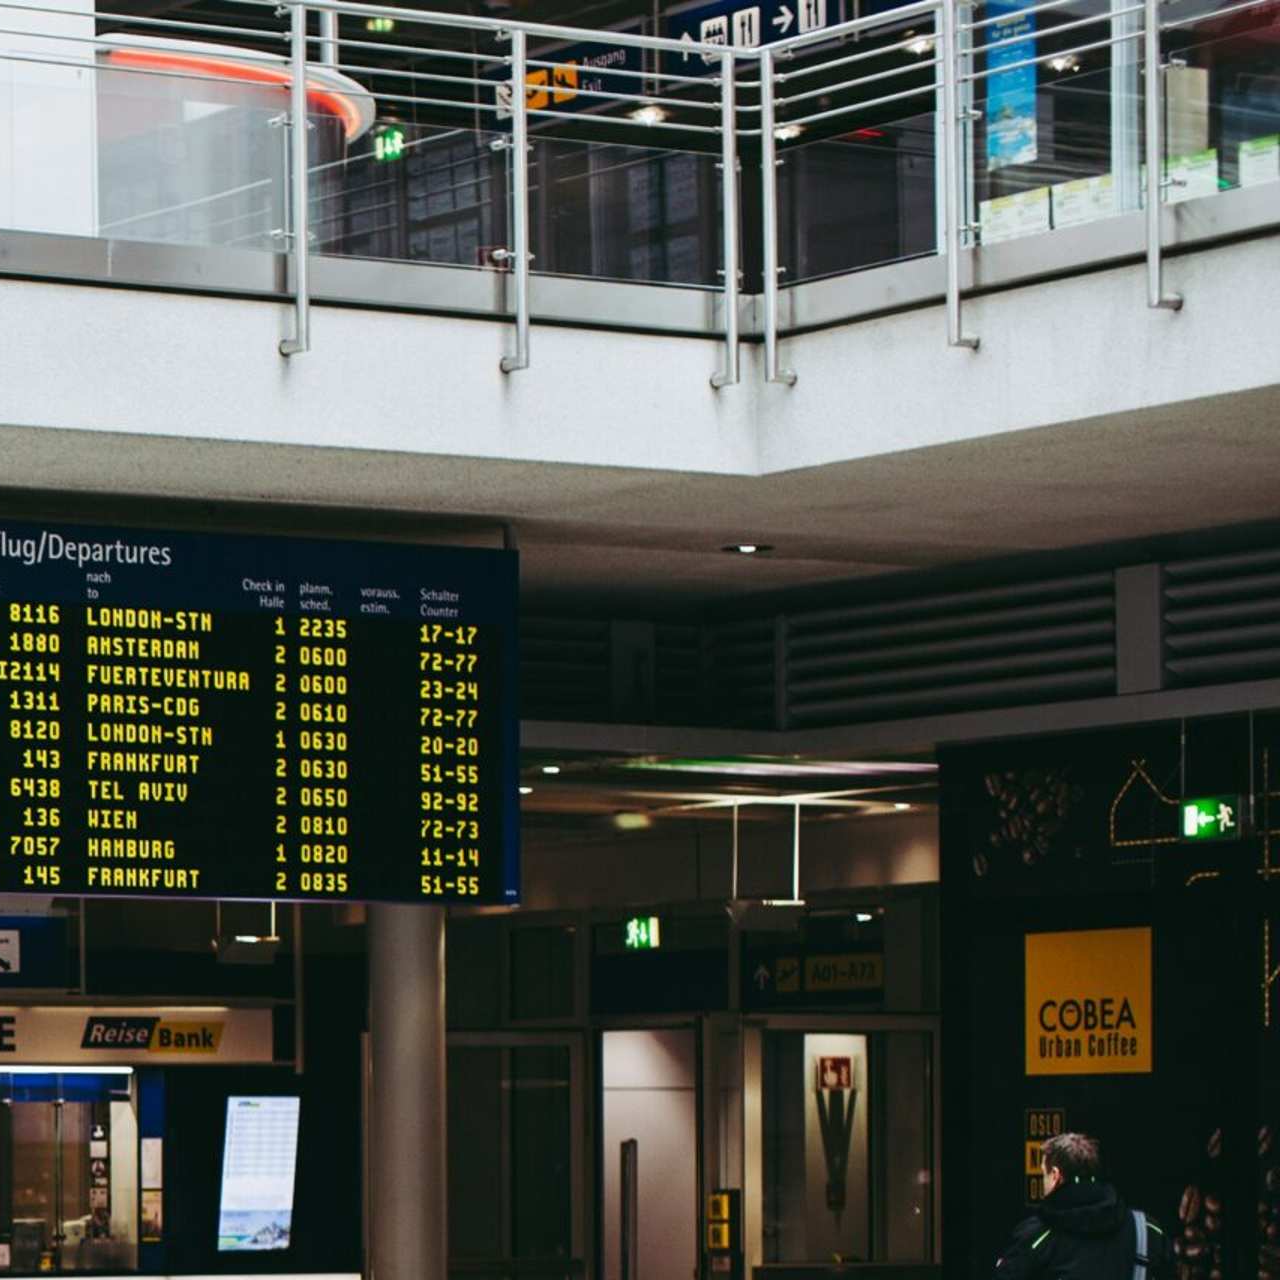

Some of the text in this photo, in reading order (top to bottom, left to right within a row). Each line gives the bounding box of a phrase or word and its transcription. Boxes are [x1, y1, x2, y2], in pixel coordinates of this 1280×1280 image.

[582, 47, 627, 71] Ausgang
[9, 604, 60, 623] 8116
[86, 608, 212, 631] LONDON-STN
[275, 618, 286, 634] 1
[299, 618, 347, 638] 2235
[420, 625, 477, 644] 17-17
[10, 691, 60, 710] 1311
[87, 694, 200, 716] PARIS-CDG
[275, 702, 286, 720] 2
[300, 703, 347, 722] 0610
[420, 708, 478, 727] 72-77
[24, 750, 60, 768] 143
[87, 752, 200, 773] FRANKFURT
[276, 759, 287, 776] 2
[300, 760, 348, 778] 0630
[421, 764, 479, 783] 51-55
[23, 808, 60, 826] 136
[88, 810, 137, 828] WIEN
[276, 816, 286, 833] 2
[300, 816, 348, 835] 0810
[421, 820, 479, 838] 72-73
[10, 836, 60, 855] 7057
[88, 839, 175, 858] HAMBURG
[276, 844, 287, 861] 1
[301, 845, 348, 863] 0820
[421, 848, 479, 866] 11-14
[1039, 996, 1137, 1033] COBEA
[88, 1022, 215, 1049] Reise Bank
[1039, 1034, 1138, 1058] Urban Coffee
[1029, 1111, 1063, 1136] OSLO
